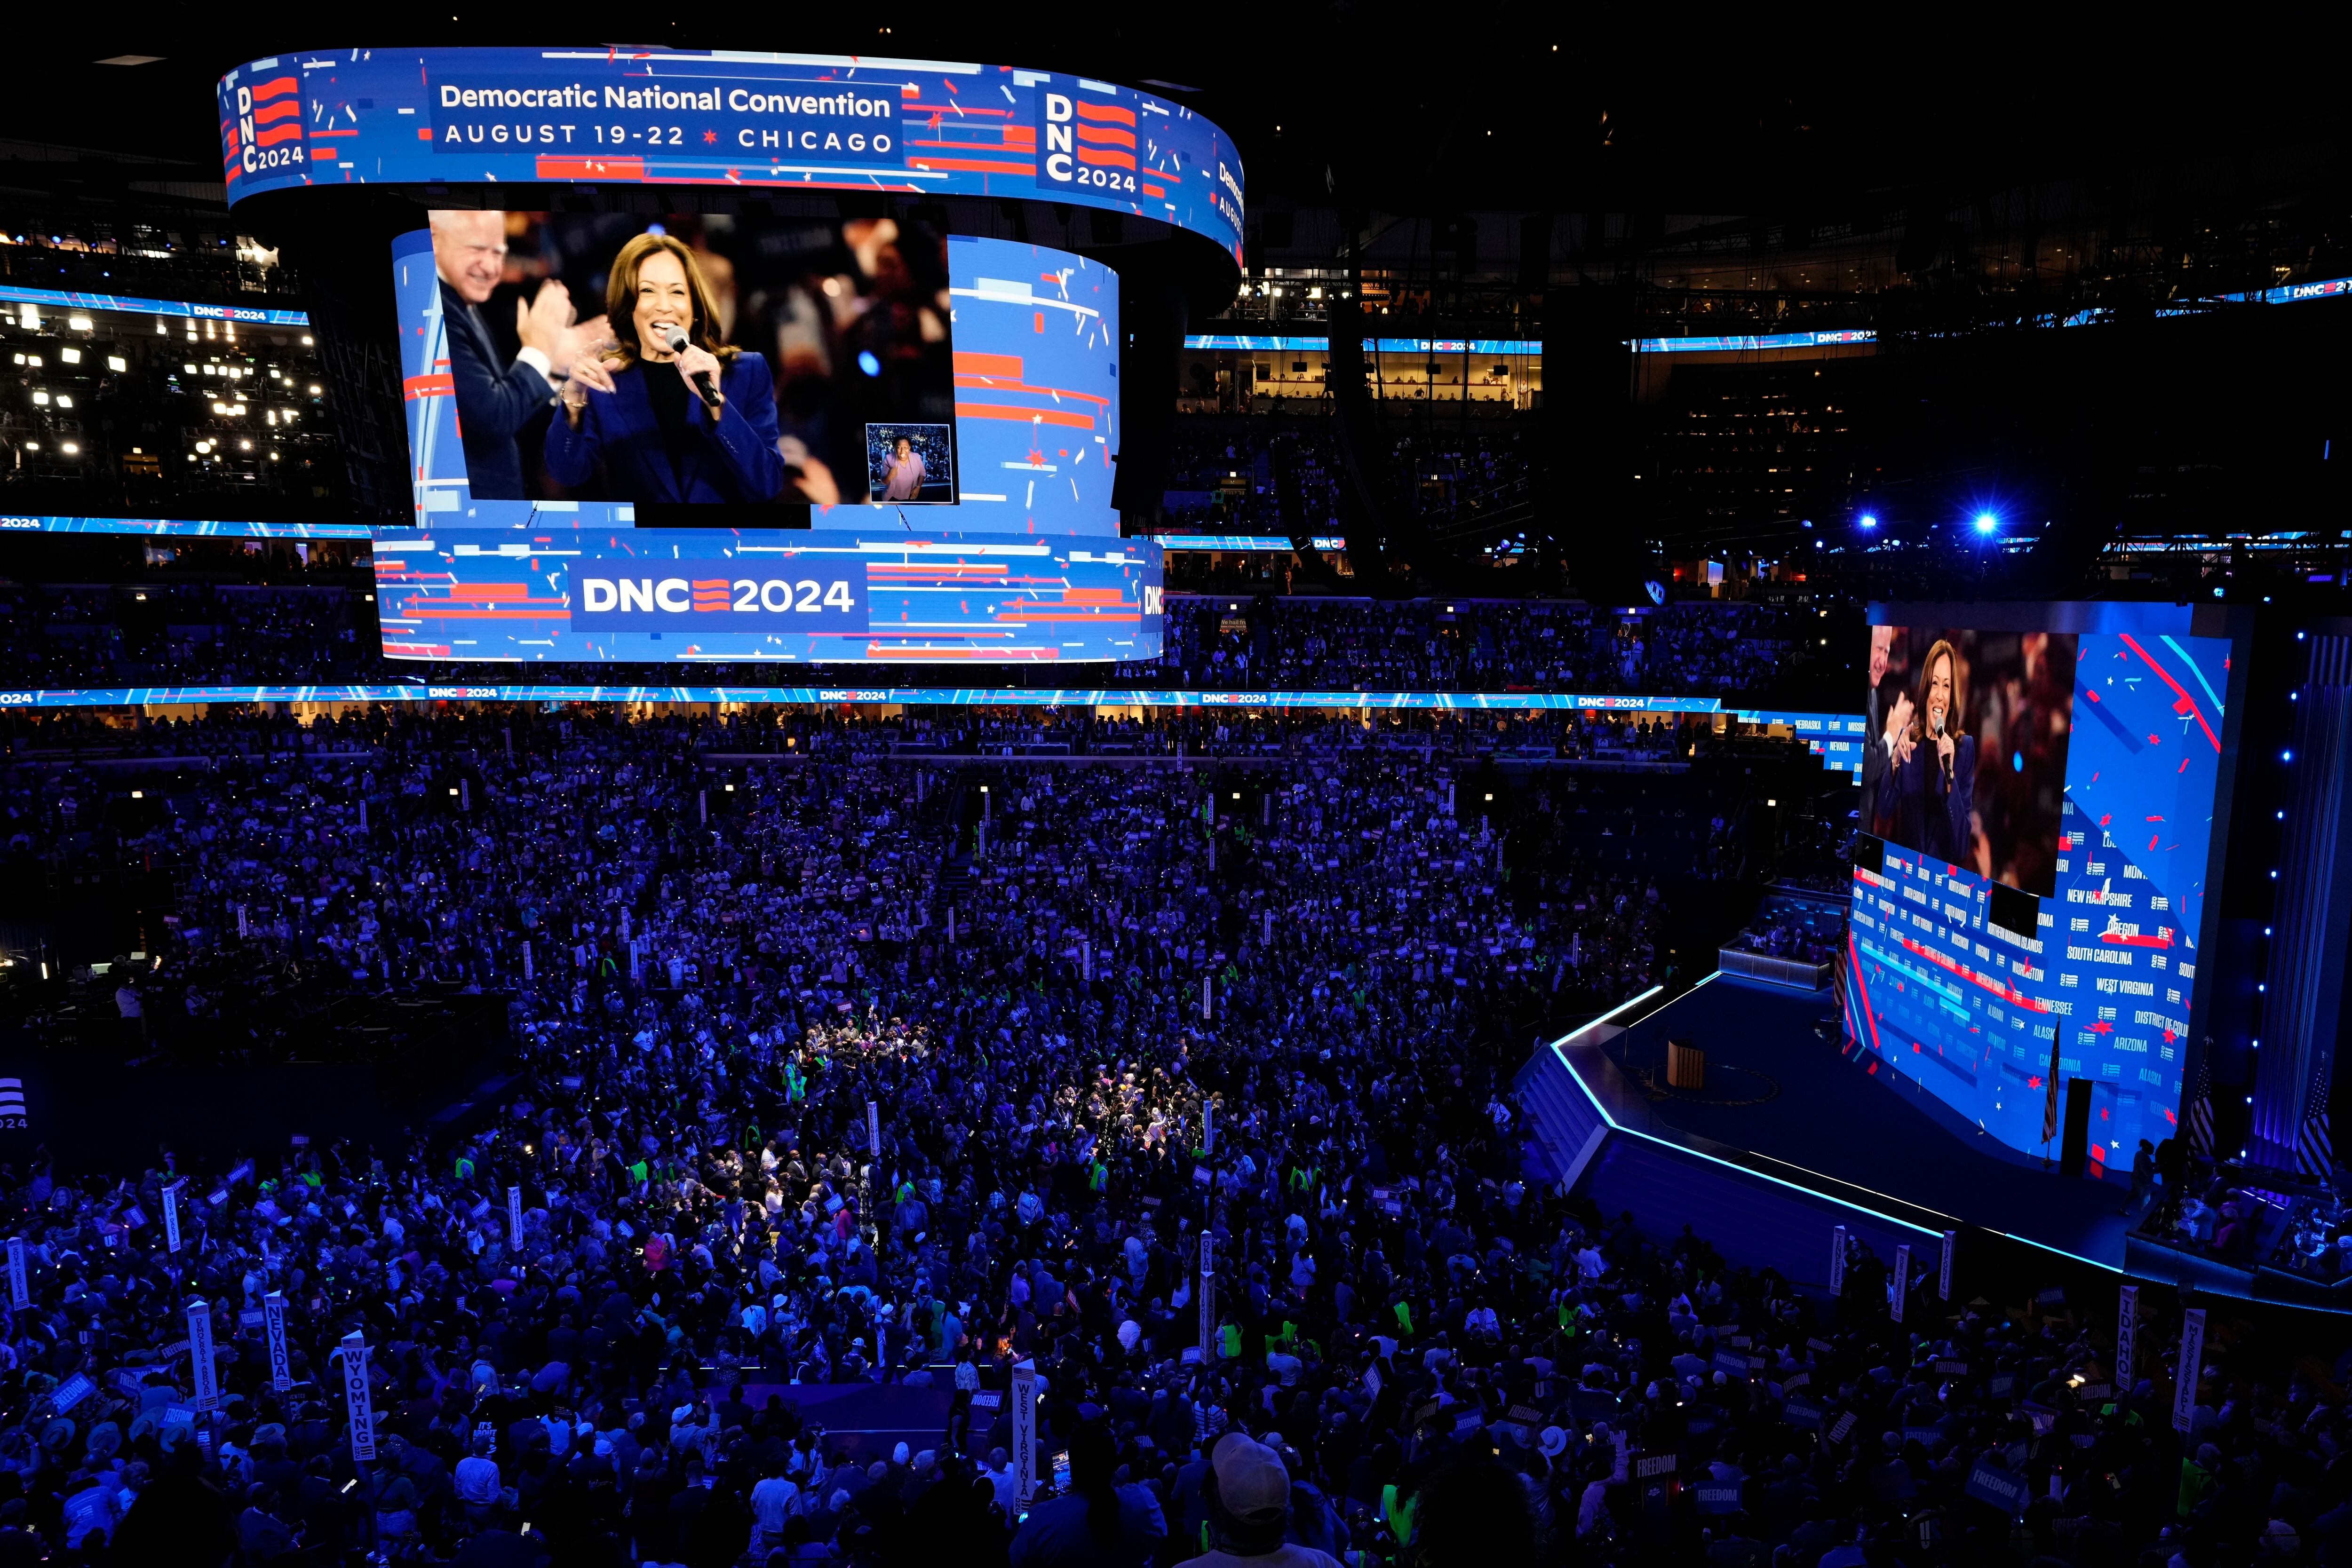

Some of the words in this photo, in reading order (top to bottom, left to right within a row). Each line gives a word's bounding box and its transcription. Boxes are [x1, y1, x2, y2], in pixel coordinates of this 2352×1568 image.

[441, 84, 596, 108] Democratic
[605, 85, 721, 111] National
[728, 89, 890, 118] Convention
[237, 87, 256, 173] DNC
[445, 125, 576, 143] AUGUST
[595, 126, 683, 145] 19-22
[1046, 93, 1072, 182] DNC
[739, 128, 891, 153] CHICAGO
[259, 146, 304, 170] 2024
[1077, 166, 1136, 193] 2024
[1219, 197, 1241, 235] AUGUST
[2294, 284, 2325, 298] DNC
[194, 306, 223, 318] DNC
[234, 309, 266, 321] 2024
[1451, 342, 1476, 351] 2024
[1, 518, 40, 529] 2024
[1314, 539, 1338, 548] DNC
[583, 578, 689, 613] DNC
[733, 579, 854, 612] 2024
[1144, 586, 1163, 615] DNC
[429, 689, 457, 698] DNC
[467, 689, 497, 697] 2024
[820, 691, 847, 700] DNC
[856, 691, 886, 700] 2024
[1202, 694, 1229, 703] DNC
[1238, 694, 1267, 703] 2024
[1578, 698, 1605, 706] DNC
[1614, 698, 1645, 707] 2024
[1795, 720, 1821, 730] NEBRASKA
[1829, 741, 1850, 752] NEVADA
[1918, 867, 1930, 882] OREGON
[1948, 879, 1959, 893] NORTH
[1958, 883, 1971, 898] DAKOTA
[2067, 888, 2085, 903] NEW
[1987, 921, 2005, 941] NORTHERN
[2004, 928, 2022, 947] MARIANA
[2021, 936, 2043, 954] ISLANDS
[2107, 921, 2139, 937] OREGON
[2067, 946, 2094, 961] SOUTH
[2094, 949, 2132, 965] CAROLINA
[2012, 960, 2044, 982] WASHINGTON
[1976, 971, 1993, 990] AMERICAN
[1993, 979, 2005, 996] SAMOA
[2097, 978, 2119, 992] WEST
[2120, 980, 2153, 996] VIRGINIA
[1987, 1004, 2003, 1022] ALABAMA
[2034, 996, 2073, 1015] TENNESSEE
[2114, 1037, 2147, 1053] ARIZONA
[2139, 1068, 2161, 1087] ALASKA
[229, 1165, 248, 1181] FREEDOM
[210, 1189, 226, 1204] FREEDOM
[1142, 1196, 1162, 1207] FREEDOM
[471, 1201, 490, 1218] FREEDOM
[1832, 1235, 1841, 1287] TENNESSEE
[1941, 1240, 1950, 1290] WISCONSIN
[1893, 1278, 1902, 1311] CAROLINA
[2040, 1290, 2063, 1302] FREEDOM
[241, 1311, 263, 1324] FREEDOM
[1718, 1324, 1739, 1336] FREEDOM
[2118, 1299, 2131, 1374] IDAHO
[161, 1339, 191, 1359] FREEDOM
[268, 1306, 283, 1377] NEVADA
[1732, 1336, 1750, 1347] FREEDOM
[1806, 1338, 1832, 1353] FREEDOM
[196, 1318, 206, 1363] DEMOCRATS
[201, 1367, 210, 1396] ABROAD
[1182, 1350, 1200, 1362] FREEDOM
[1716, 1353, 1746, 1370] FREEDOM
[1936, 1362, 1967, 1375] FREEDOM
[2181, 1325, 2198, 1414] MISSISSIPPI
[1366, 1367, 1381, 1396] FREEDOM
[1783, 1373, 1810, 1393] FREEDOM
[53, 1377, 89, 1410] FREEDOM
[344, 1350, 370, 1443] WYOMING
[970, 1394, 1000, 1407] FREEDOM
[1017, 1383, 1030, 1420] WEST
[2081, 1384, 2111, 1401] FREEDOM
[164, 1408, 195, 1423] FREEDOM
[1414, 1402, 1437, 1425] FREEDOM
[1508, 1404, 1543, 1422] FREEDOM
[1787, 1404, 1821, 1419] FREEDOM
[1828, 1411, 1858, 1445] FREEDOM
[1019, 1425, 1029, 1496] VIRGINIA
[2006, 1443, 2027, 1463] FREEDOM
[1637, 1454, 1676, 1478] FREEDOM
[1972, 1469, 2018, 1498] FREEDOM
[1698, 1489, 1737, 1502] FREEDOM
